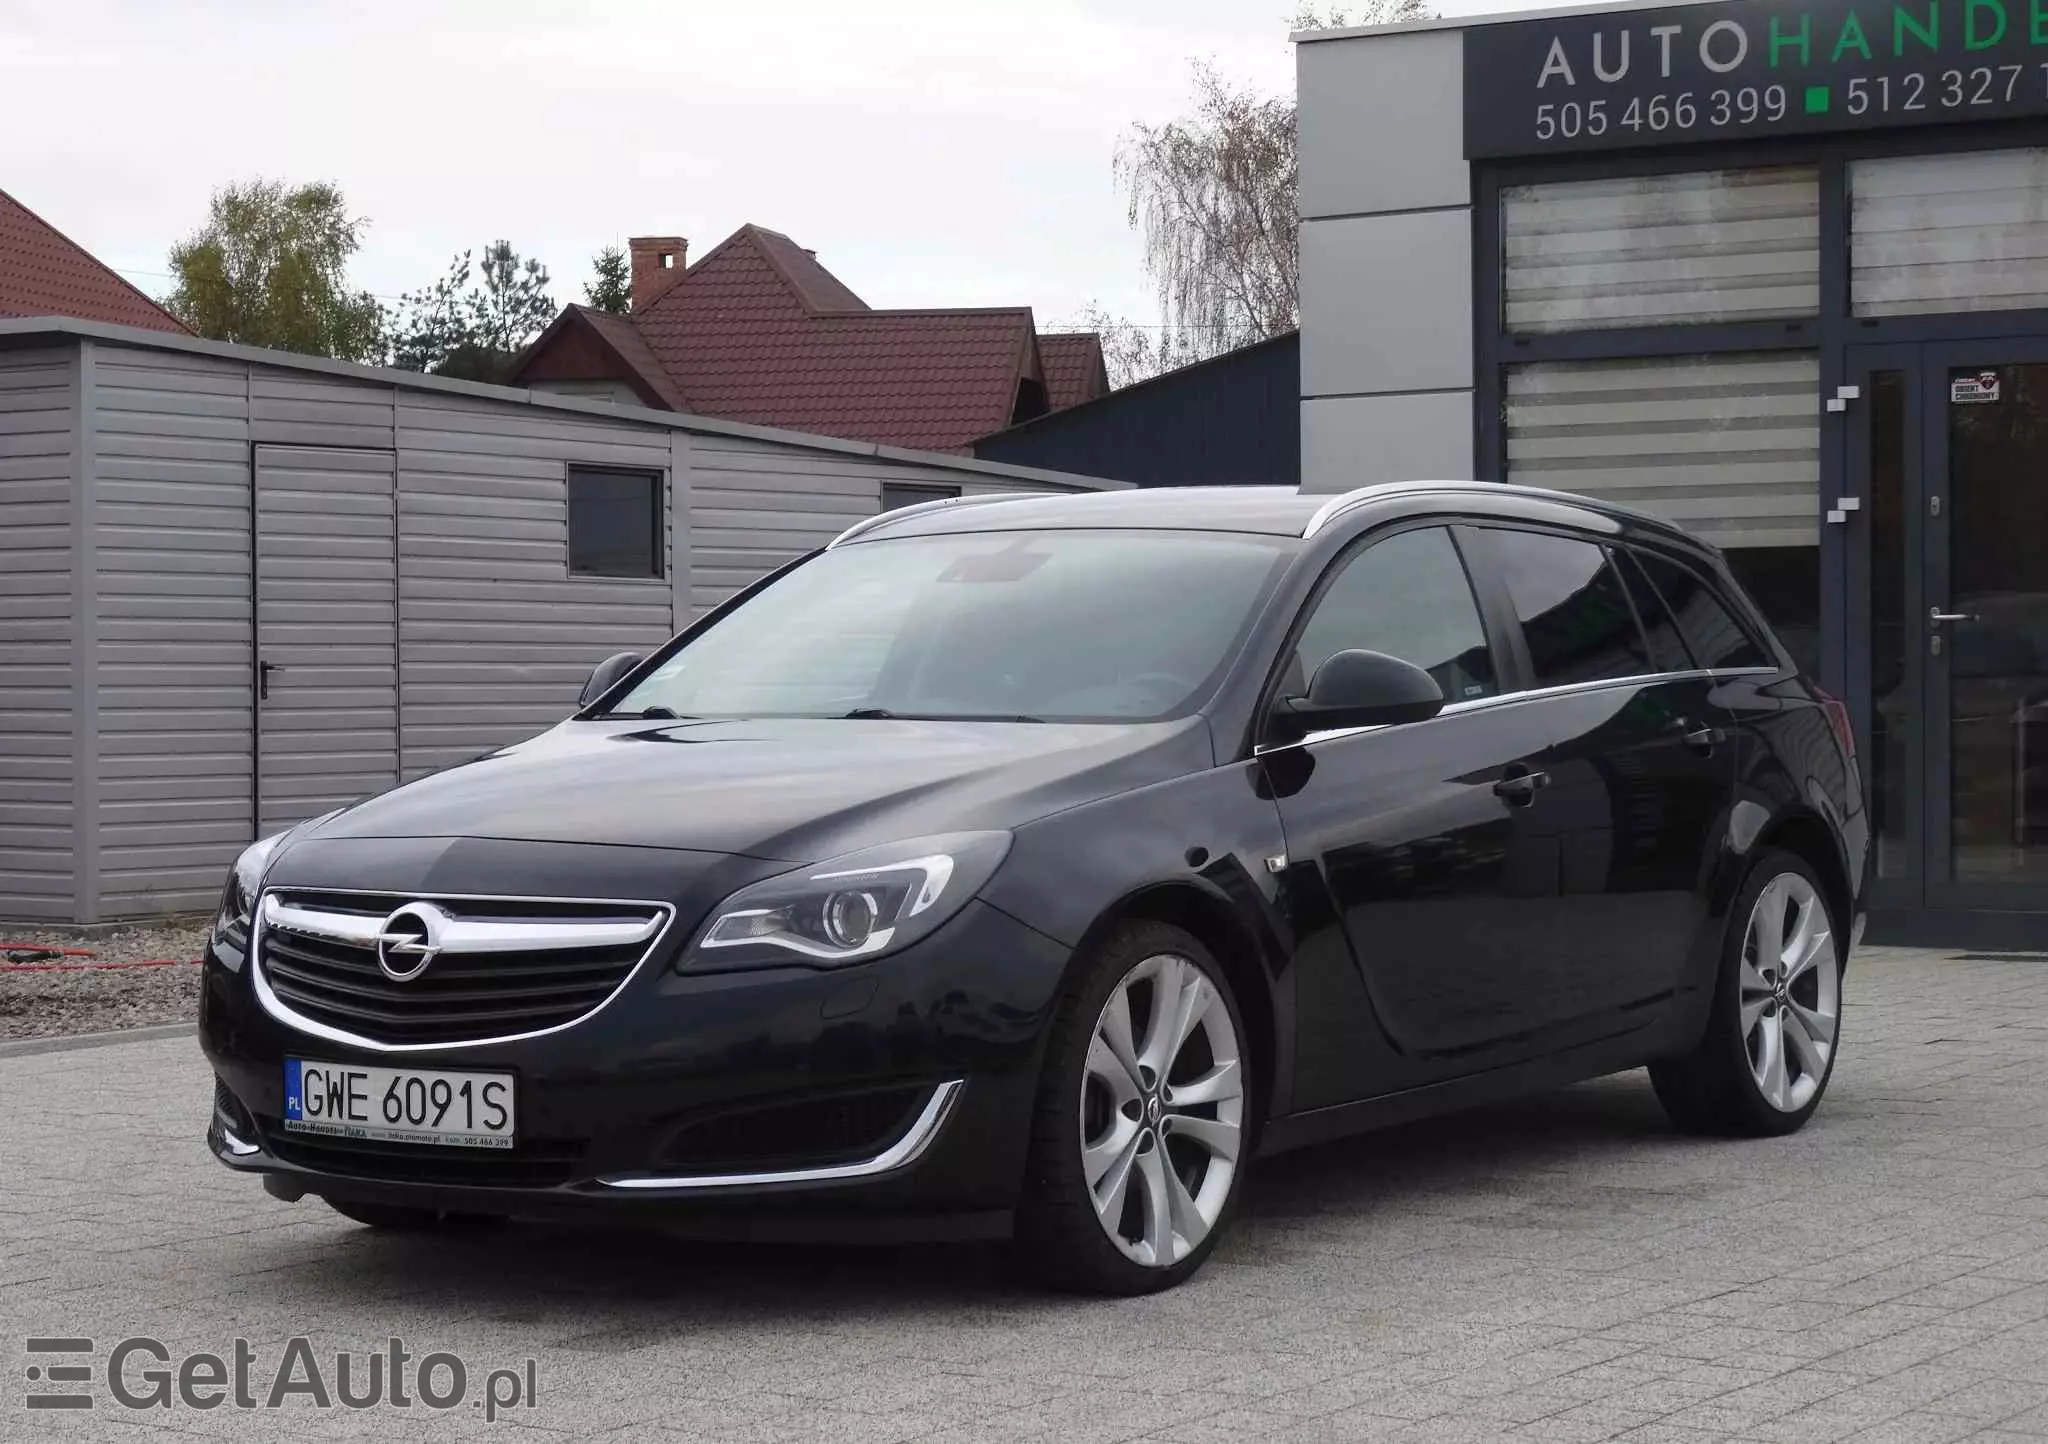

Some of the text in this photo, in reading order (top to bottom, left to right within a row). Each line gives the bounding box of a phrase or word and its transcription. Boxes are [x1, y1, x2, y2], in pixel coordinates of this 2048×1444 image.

[1536, 99, 1608, 140] 505
[1620, 92, 1697, 132] 466
[1710, 84, 1787, 126] 399
[1847, 73, 1926, 115] 512
[1941, 64, 2023, 107] 327
[288, 1096, 301, 1111] PL
[304, 1068, 508, 1131] GWE 6091S
